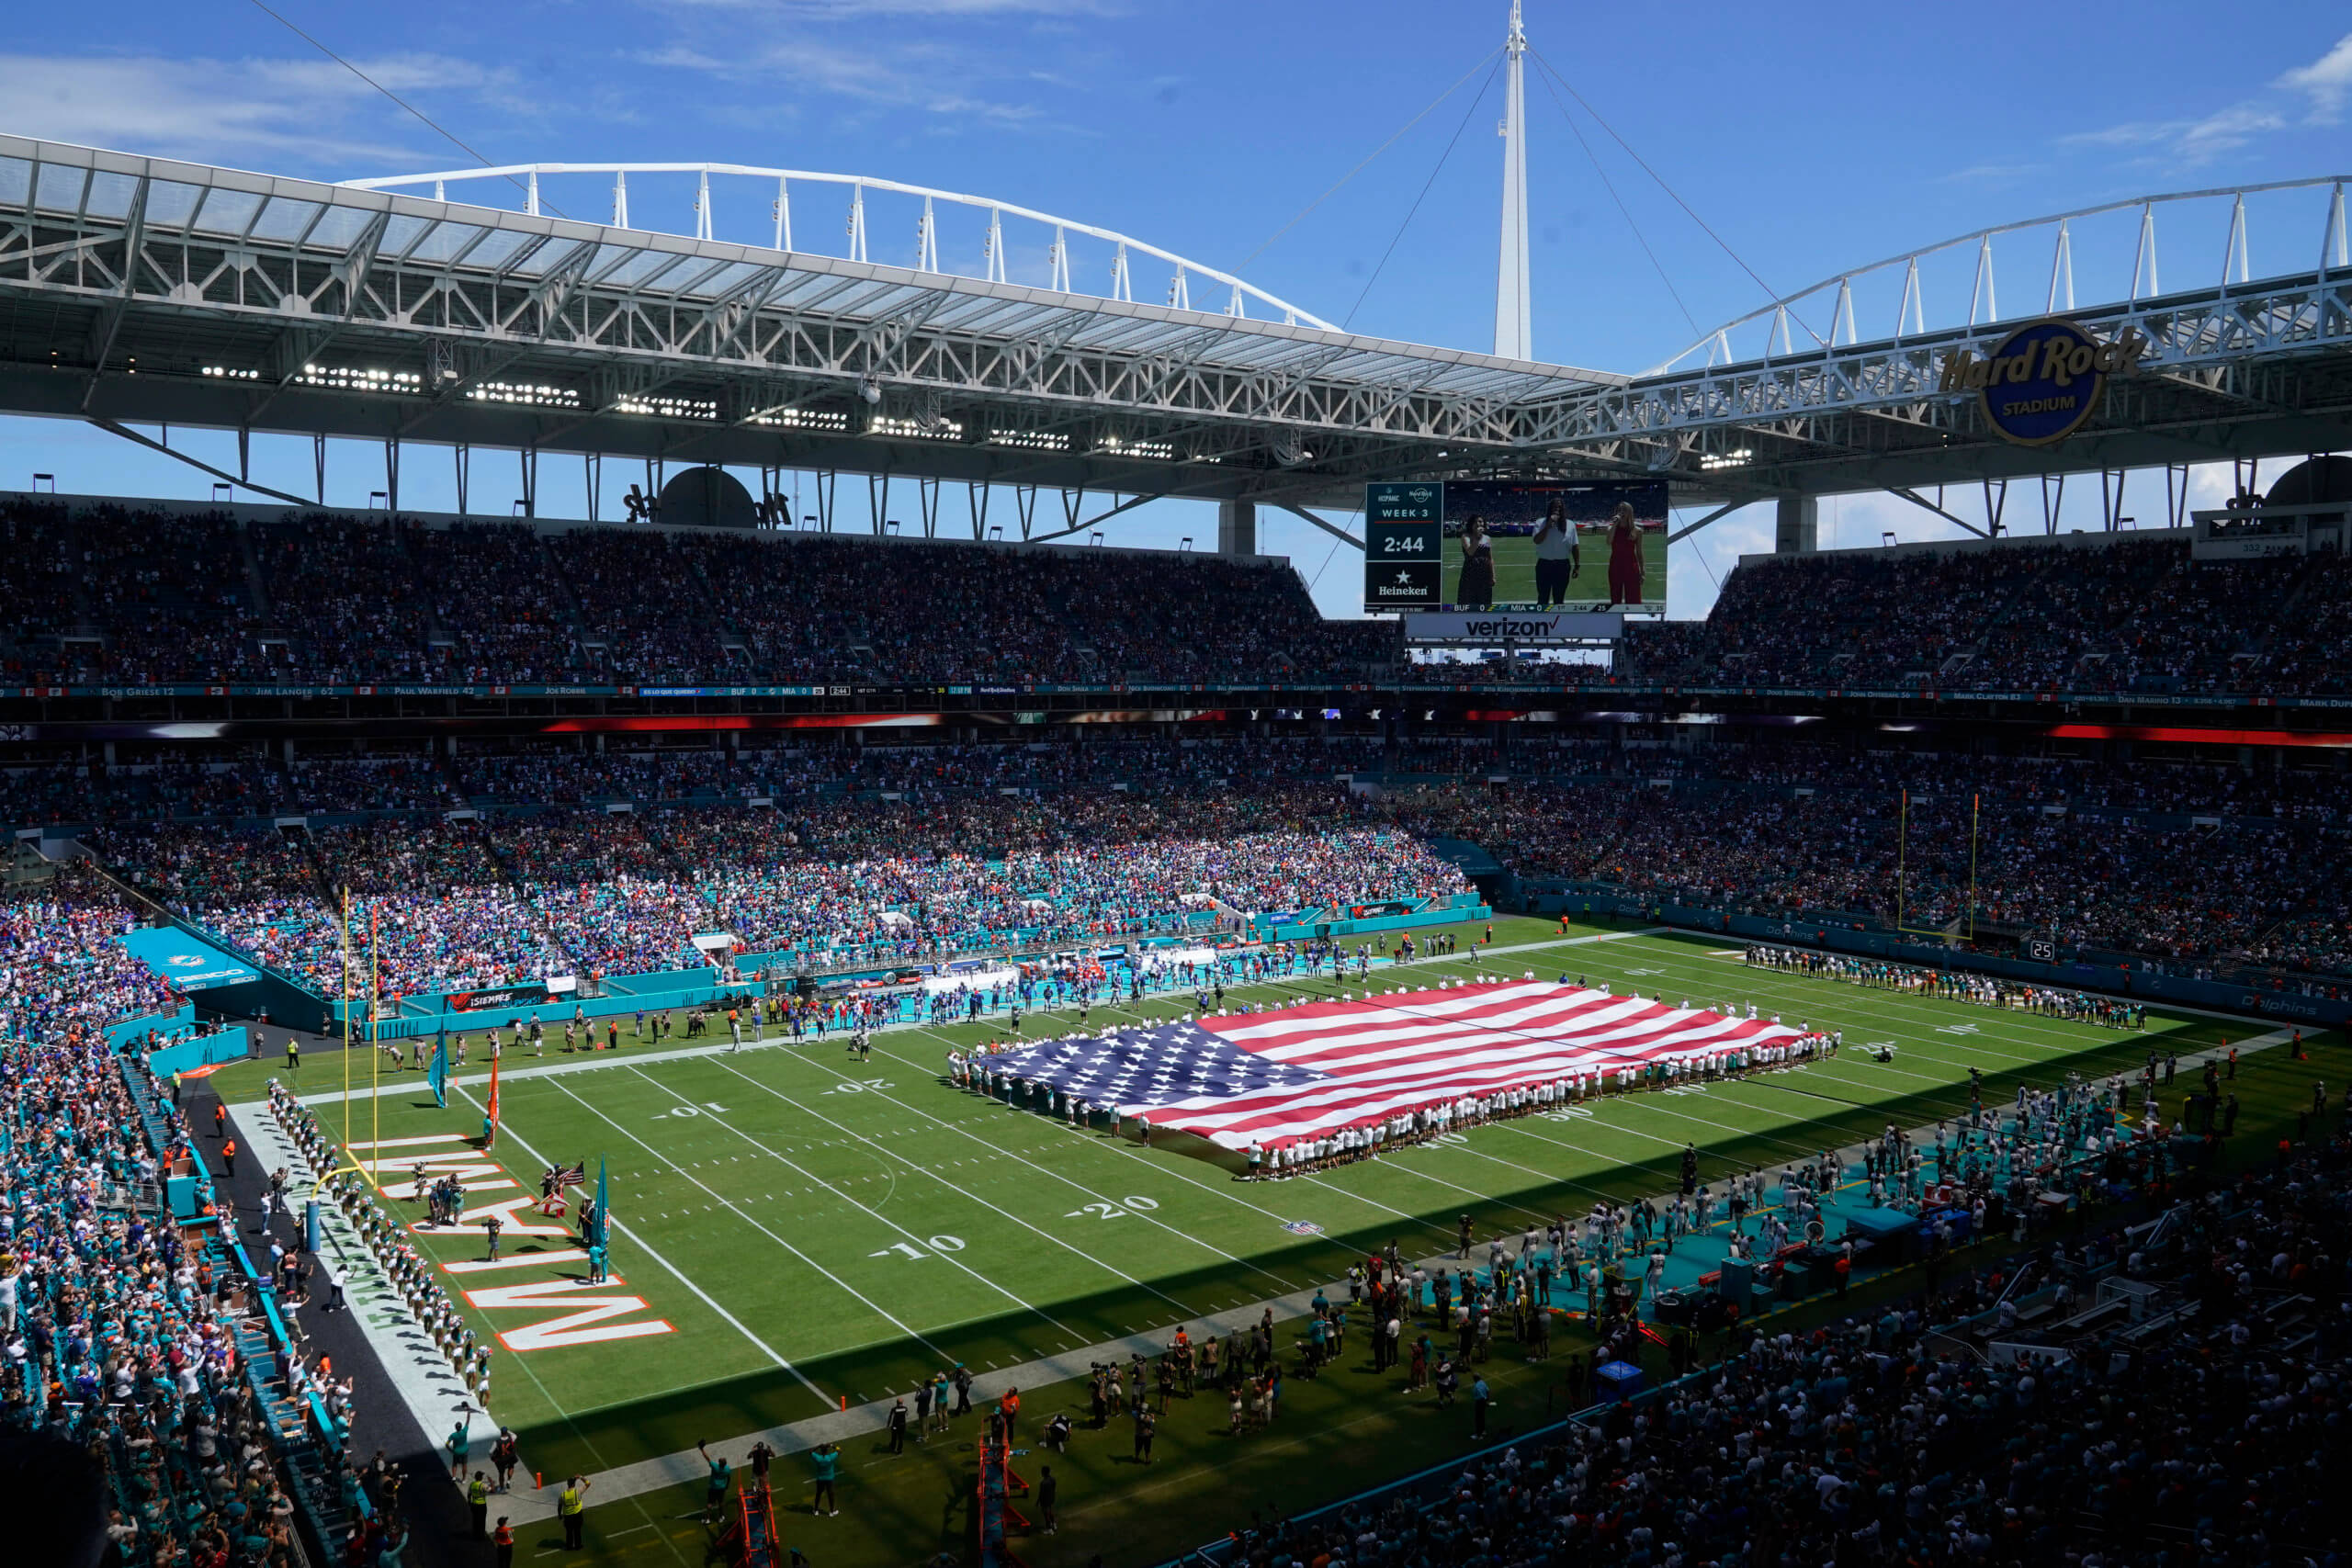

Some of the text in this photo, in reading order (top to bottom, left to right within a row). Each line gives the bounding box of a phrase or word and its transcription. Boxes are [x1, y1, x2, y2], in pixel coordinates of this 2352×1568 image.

[1938, 325, 2150, 392] Hard Rock
[2002, 396, 2076, 417] STADIUM
[1382, 509, 1429, 518] WEEK 3
[1384, 536, 1425, 552] 2:44
[1378, 586, 1429, 596] Heineken
[1465, 617, 1549, 637] verizon
[102, 688, 175, 696] BOB GRIESE 12
[255, 687, 334, 696] JIM LANGER 62
[395, 687, 415, 695] PAUL
[462, 687, 475, 695] 42
[2137, 696, 2169, 705] MARINO
[2171, 696, 2181, 705] 13
[2300, 698, 2328, 706] MARK
[2033, 943, 2052, 958] 25
[837, 1078, 896, 1093] 20
[672, 1102, 731, 1117] 10
[1533, 1106, 1594, 1122] 50
[1083, 1196, 1160, 1220] 20
[343, 1134, 673, 1351] MIAMI
[890, 1235, 967, 1260] 10
